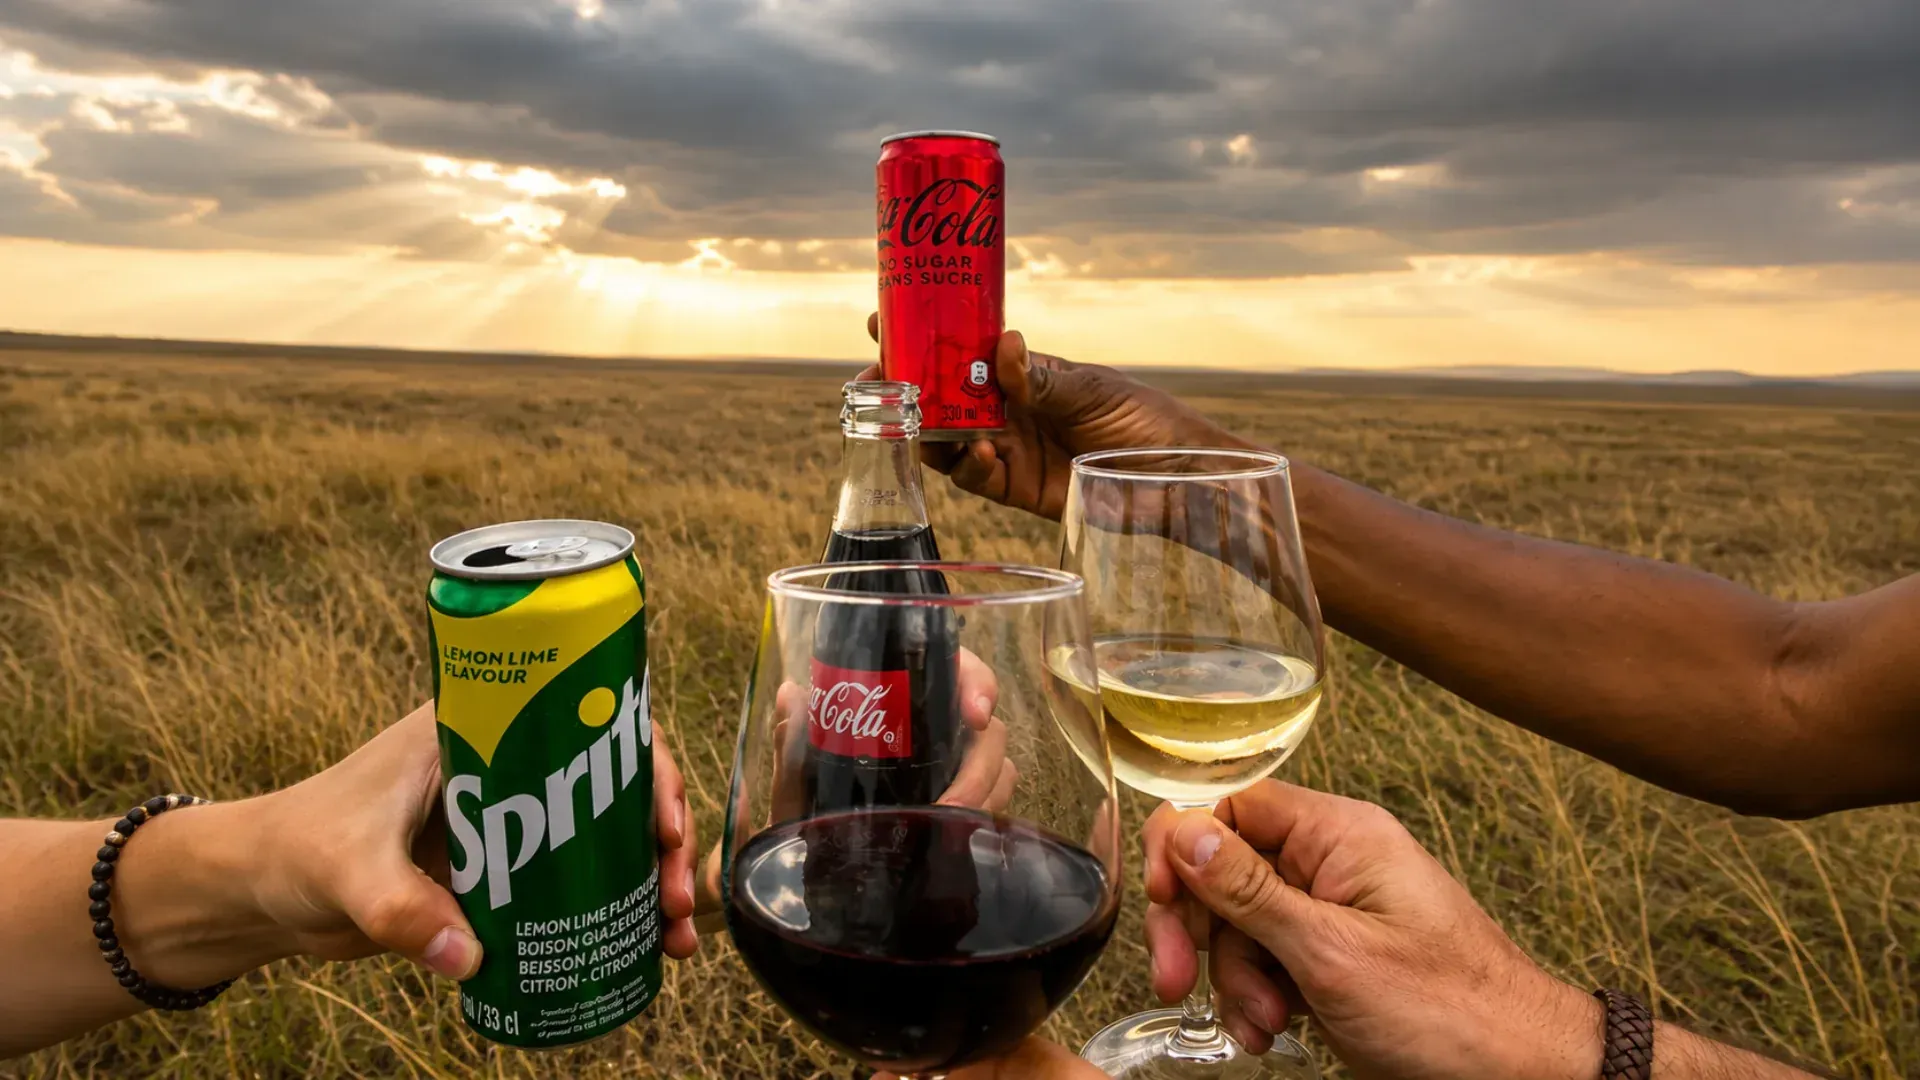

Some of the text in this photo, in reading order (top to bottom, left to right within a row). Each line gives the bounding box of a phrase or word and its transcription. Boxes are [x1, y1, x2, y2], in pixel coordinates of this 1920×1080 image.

[880, 255, 972, 271] NO SUGAR
[878, 272, 983, 290] SANS SUCRE
[444, 645, 559, 666] LEMON LIME
[445, 662, 527, 684] FLAVOUR
[516, 917, 571, 937] LEMON
[574, 907, 607, 930] LIME
[518, 935, 579, 956] BOISON
[520, 952, 586, 975] BEISSON
[520, 973, 579, 993] CITRON
[505, 1010, 519, 1036] cl
